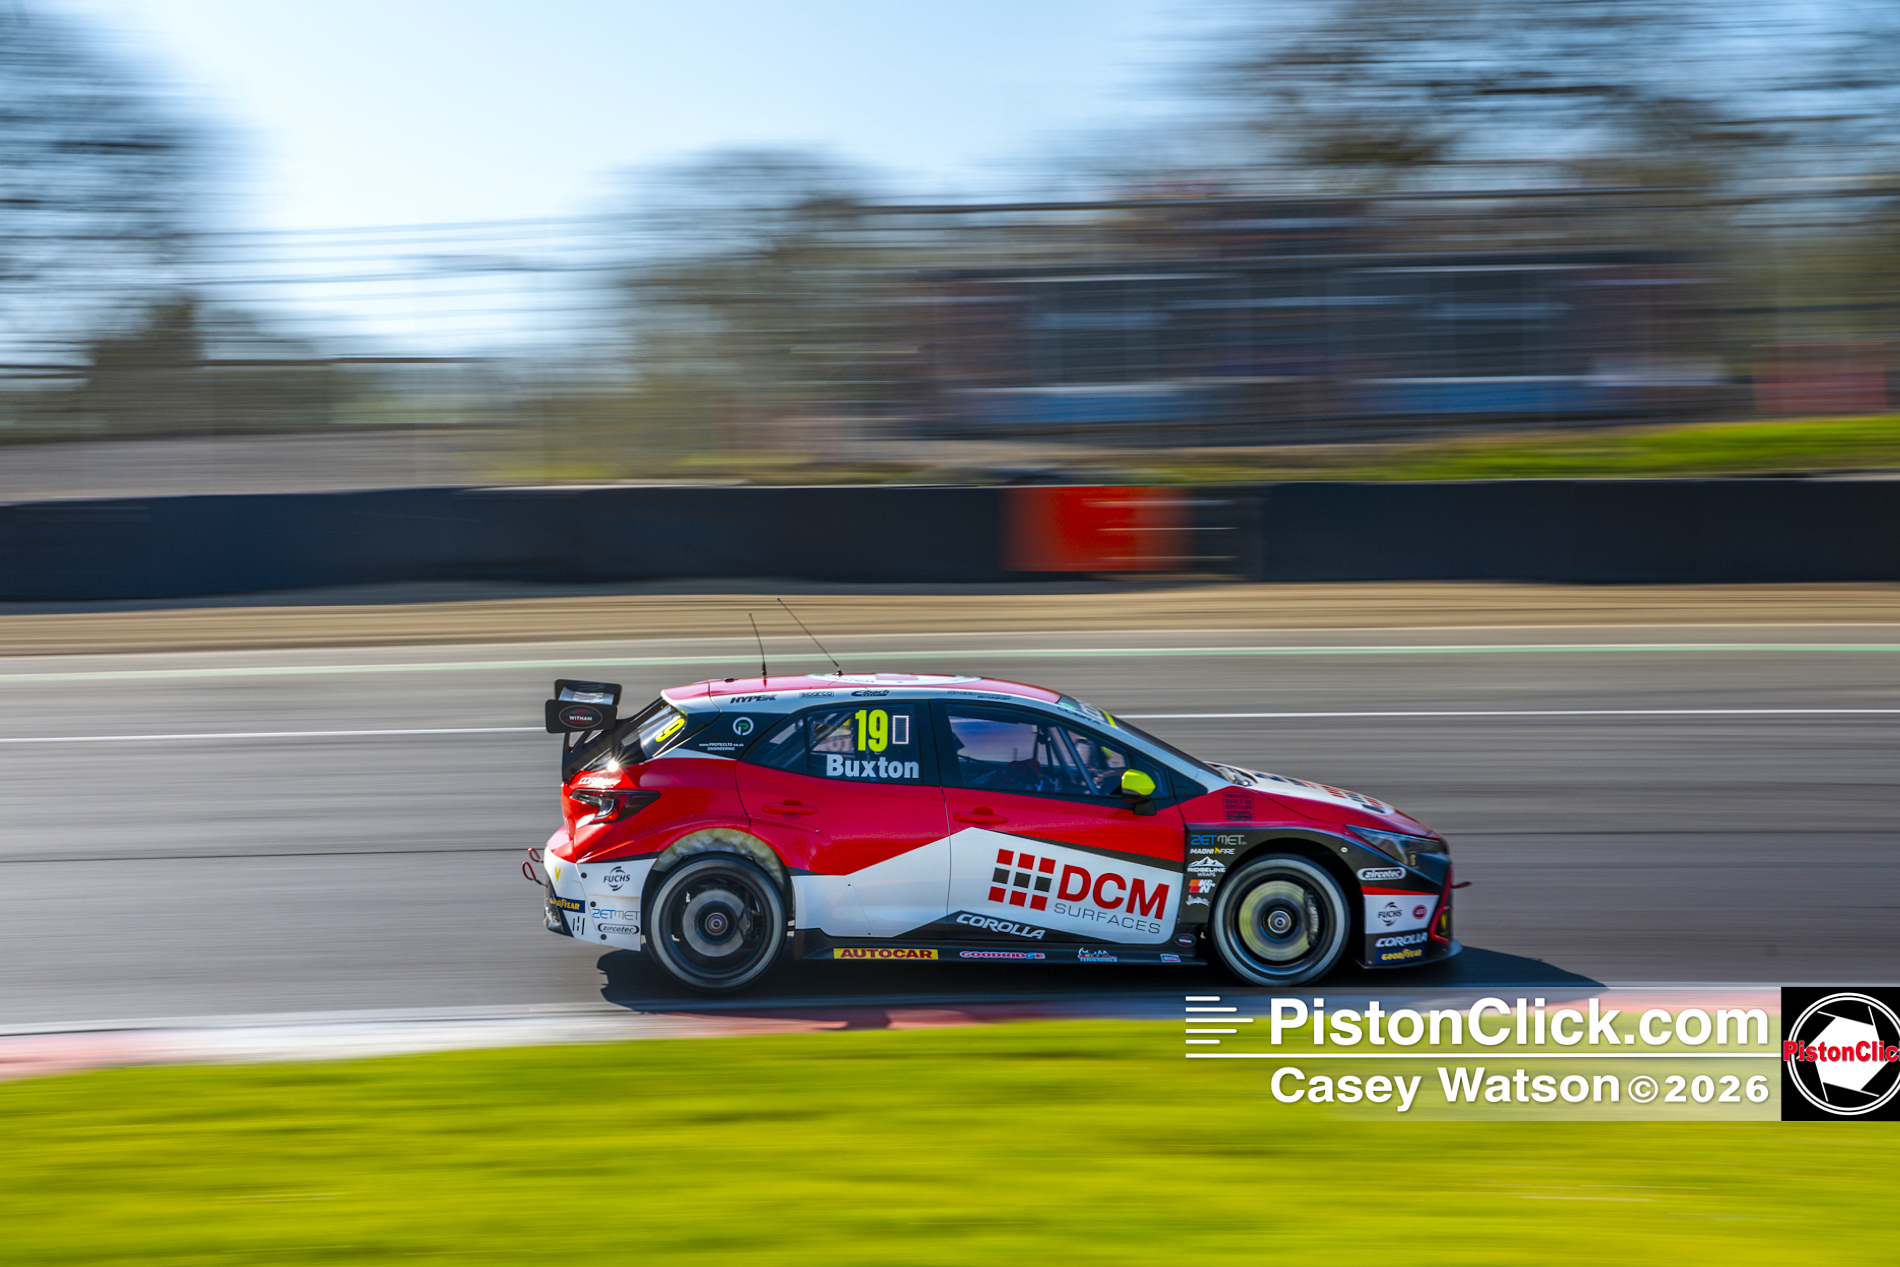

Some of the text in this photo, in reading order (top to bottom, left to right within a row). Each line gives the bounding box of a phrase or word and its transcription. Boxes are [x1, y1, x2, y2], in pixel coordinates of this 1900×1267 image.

[854, 709, 888, 752] 19
[826, 754, 920, 778] Buxton
[603, 874, 631, 883] FUCHS
[1364, 869, 1401, 879] zircotec
[1057, 864, 1170, 920] DCM
[1054, 902, 1161, 935] SURFACES
[1378, 909, 1403, 918] FUCHS
[602, 924, 634, 933] zircotec
[956, 913, 1046, 940] COROLLA
[1375, 932, 1428, 948] COROLLA
[840, 949, 933, 959] AUTOCAR
[959, 951, 1046, 960] GOODRIDGE
[1381, 949, 1422, 961] GOODYEAR
